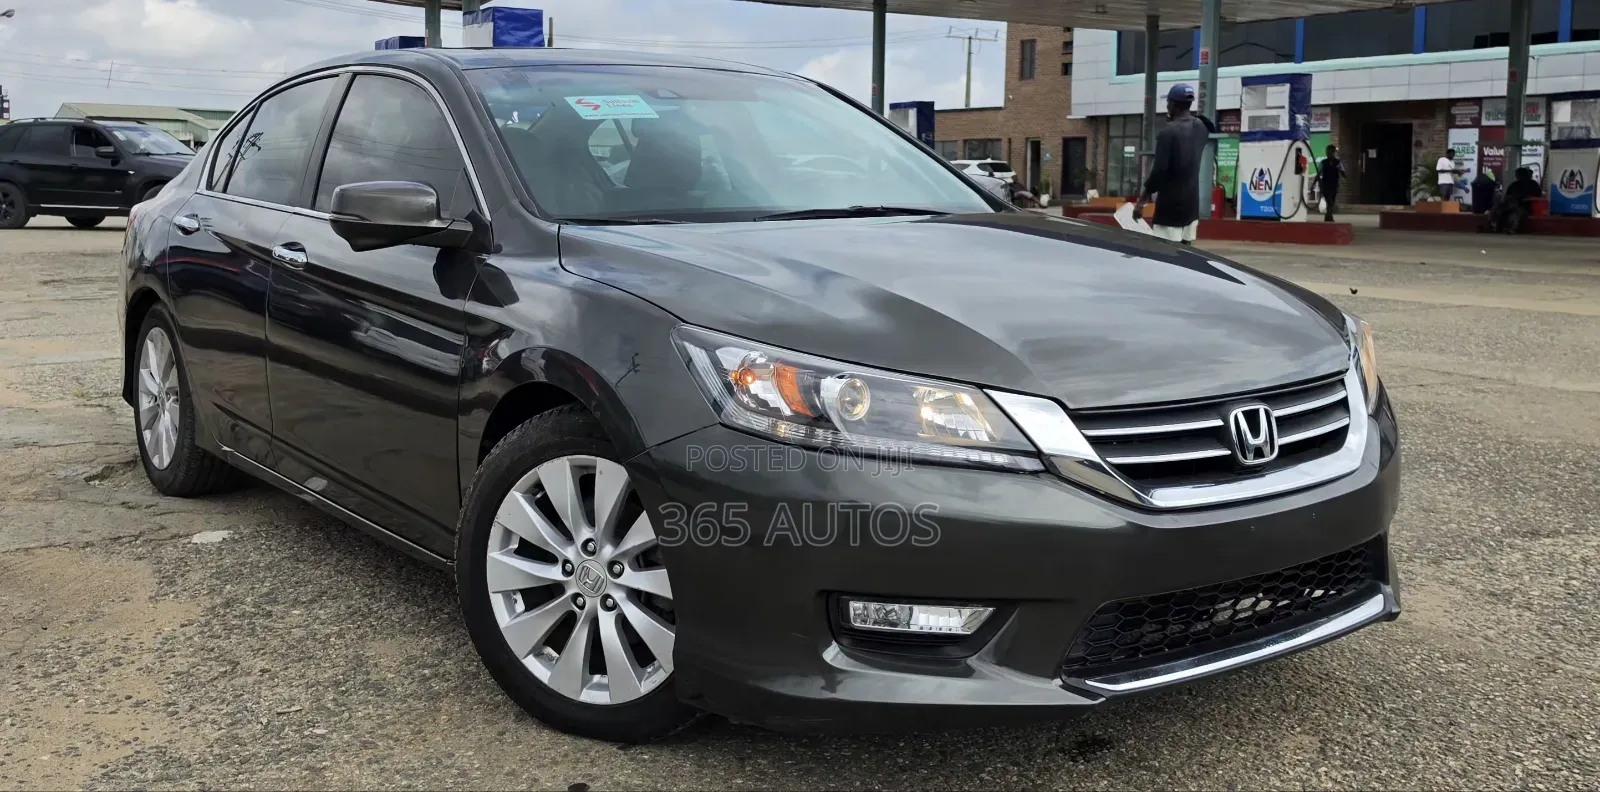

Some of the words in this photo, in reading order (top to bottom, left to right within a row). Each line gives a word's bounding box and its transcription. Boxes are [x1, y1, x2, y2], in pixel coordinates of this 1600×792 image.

[1483, 146, 1504, 156] Value
[1249, 168, 1272, 190] NEN
[1560, 169, 1583, 189] NEN
